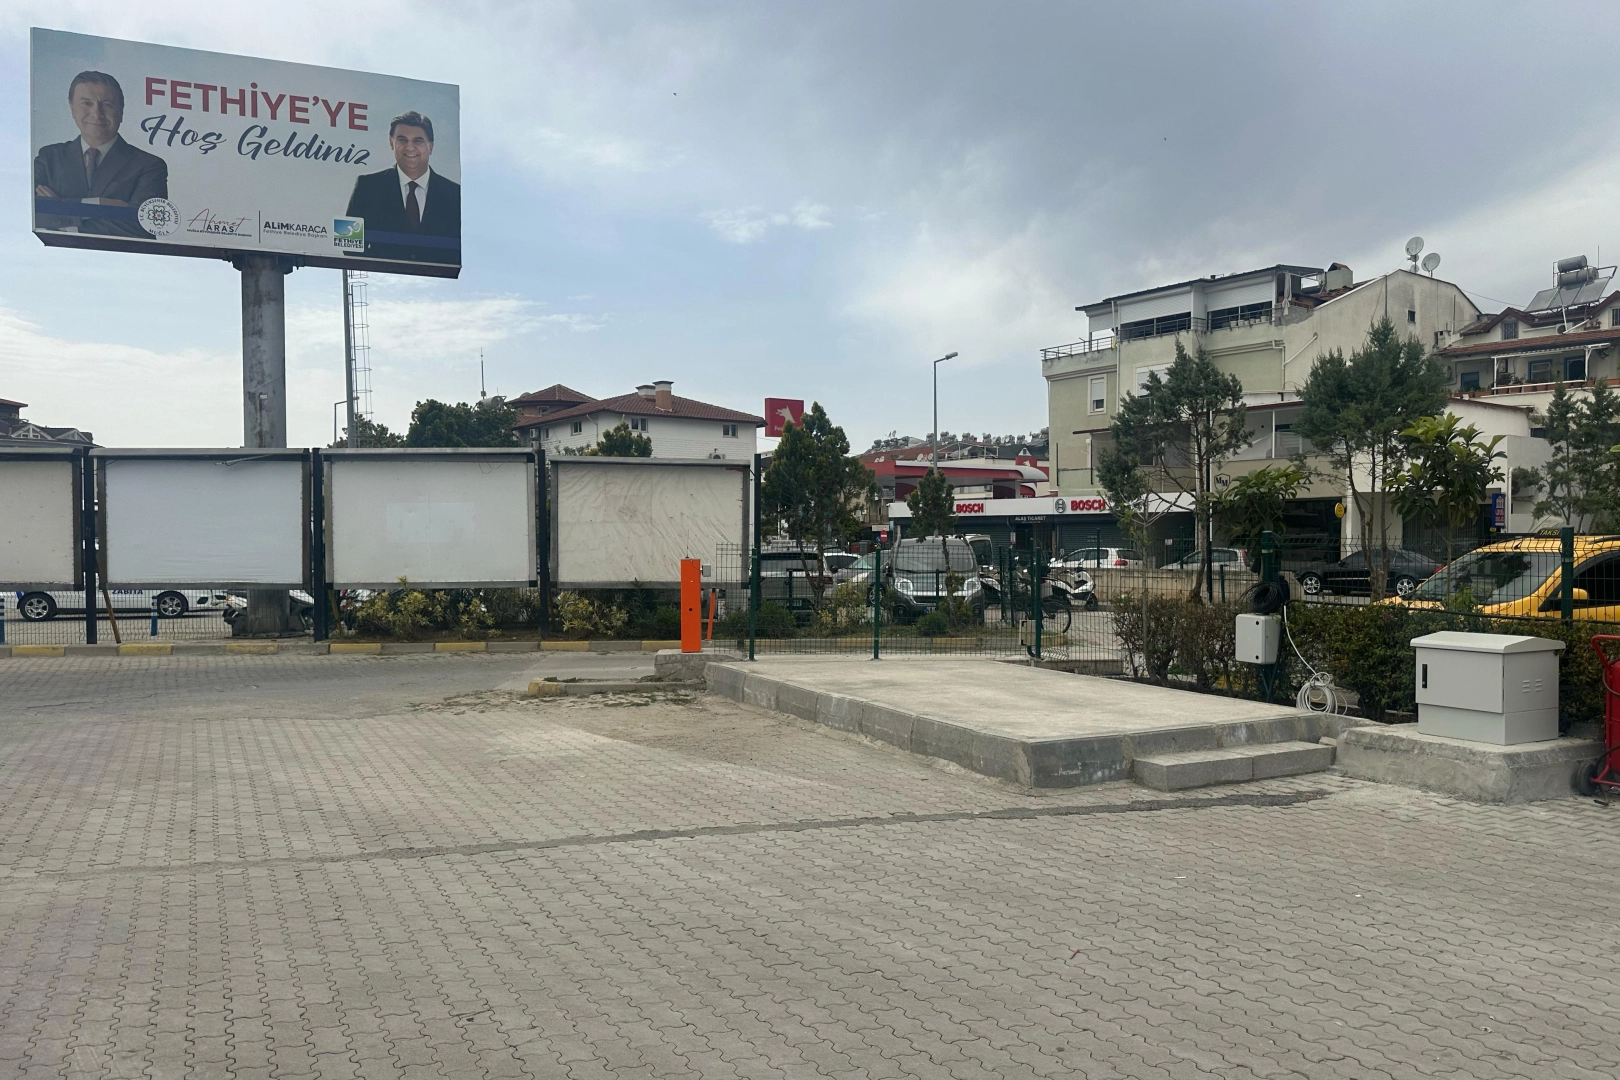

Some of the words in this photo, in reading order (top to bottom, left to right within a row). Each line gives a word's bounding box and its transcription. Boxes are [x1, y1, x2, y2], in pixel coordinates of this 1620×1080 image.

[145, 77, 369, 131] FETHİYE'YE
[140, 114, 226, 154] Hoş
[238, 124, 371, 166] Geldiniz
[187, 208, 252, 232] Ahmet
[206, 224, 235, 233] ARAS
[956, 503, 984, 513] BOSCH
[1070, 499, 1106, 511] BOSCH
